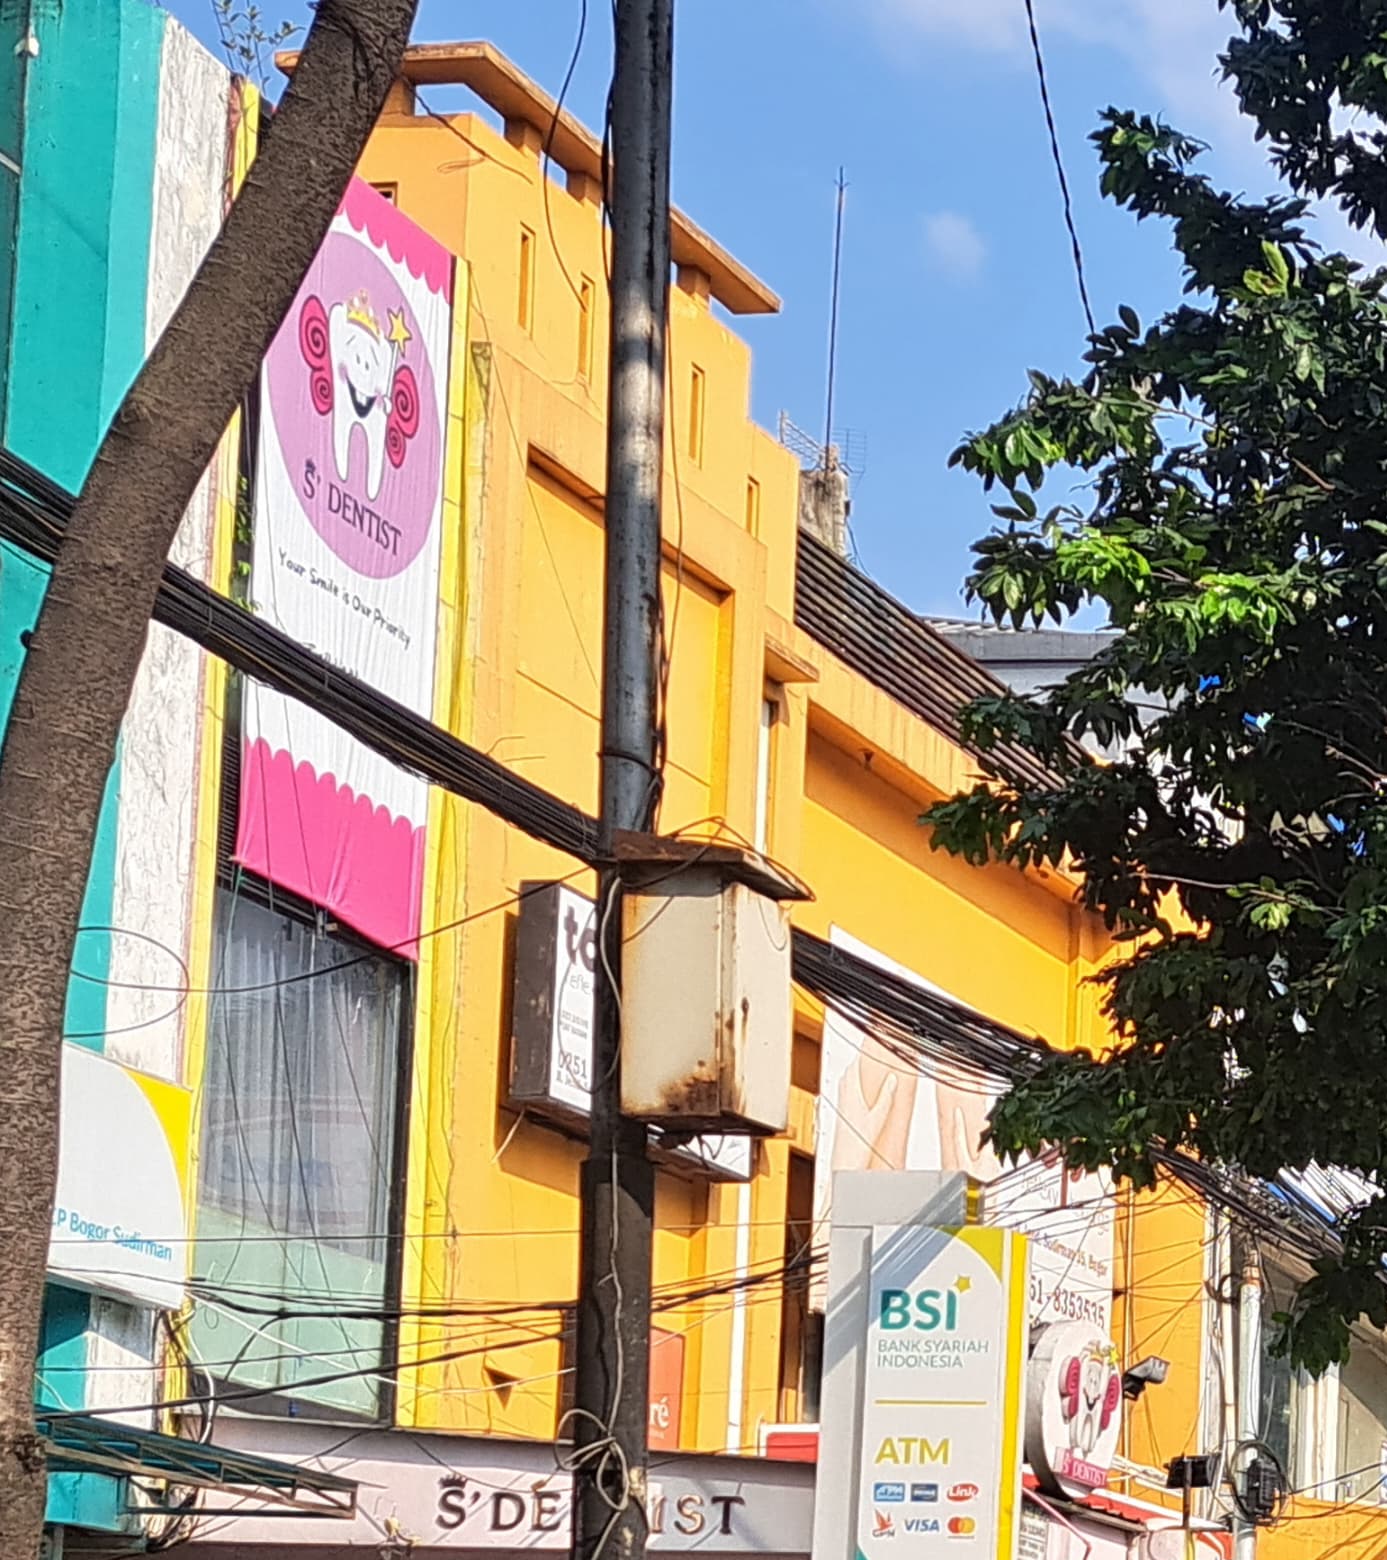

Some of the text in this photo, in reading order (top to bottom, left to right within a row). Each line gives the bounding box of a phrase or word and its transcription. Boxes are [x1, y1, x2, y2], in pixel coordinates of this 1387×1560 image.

[329, 483, 402, 556] DENTIST
[279, 548, 306, 577] Your
[309, 567, 340, 597] Smile
[352, 595, 373, 618] Our
[373, 608, 411, 651] Priority
[70, 1212, 110, 1241] Bogor
[113, 1226, 173, 1262] Sudirman
[879, 1289, 958, 1331] BSI
[877, 1354, 964, 1368] INDONESIA
[878, 1339, 989, 1353] BANK SYARIAH
[874, 1437, 950, 1465] ATM
[903, 1519, 940, 1533] VISA
